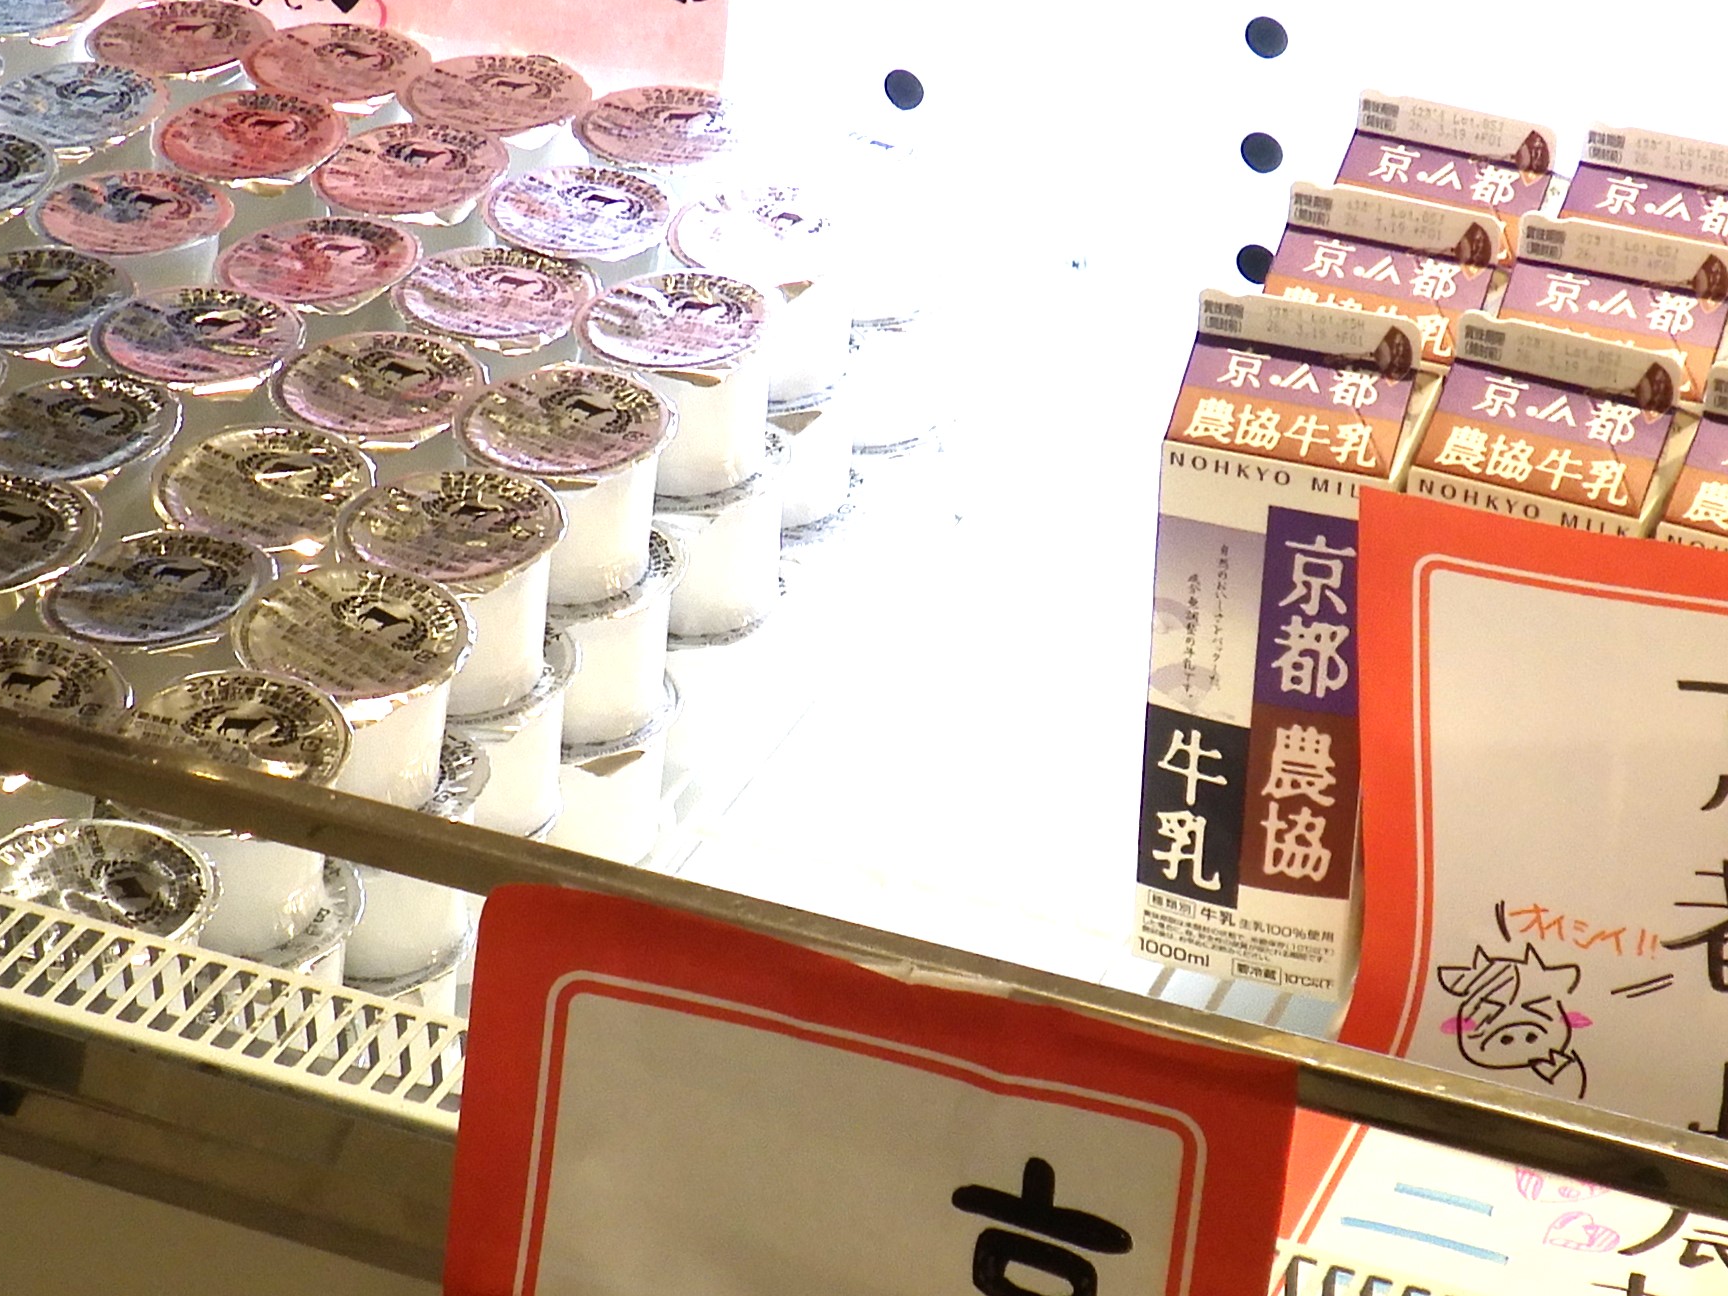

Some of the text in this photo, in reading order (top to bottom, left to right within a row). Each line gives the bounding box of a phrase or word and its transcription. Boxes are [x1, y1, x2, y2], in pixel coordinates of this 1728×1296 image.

[1184, 397, 1376, 468] 農協牛乳
[1169, 450, 1361, 500] NOHKYO MIL
[1434, 425, 1628, 507] 農協牛乳
[1419, 478, 1541, 521] NOHKYO
[1151, 727, 1229, 892] 牛乳
[1200, 907, 1236, 928] 牛乳
[1138, 935, 1210, 968] 1000ml
